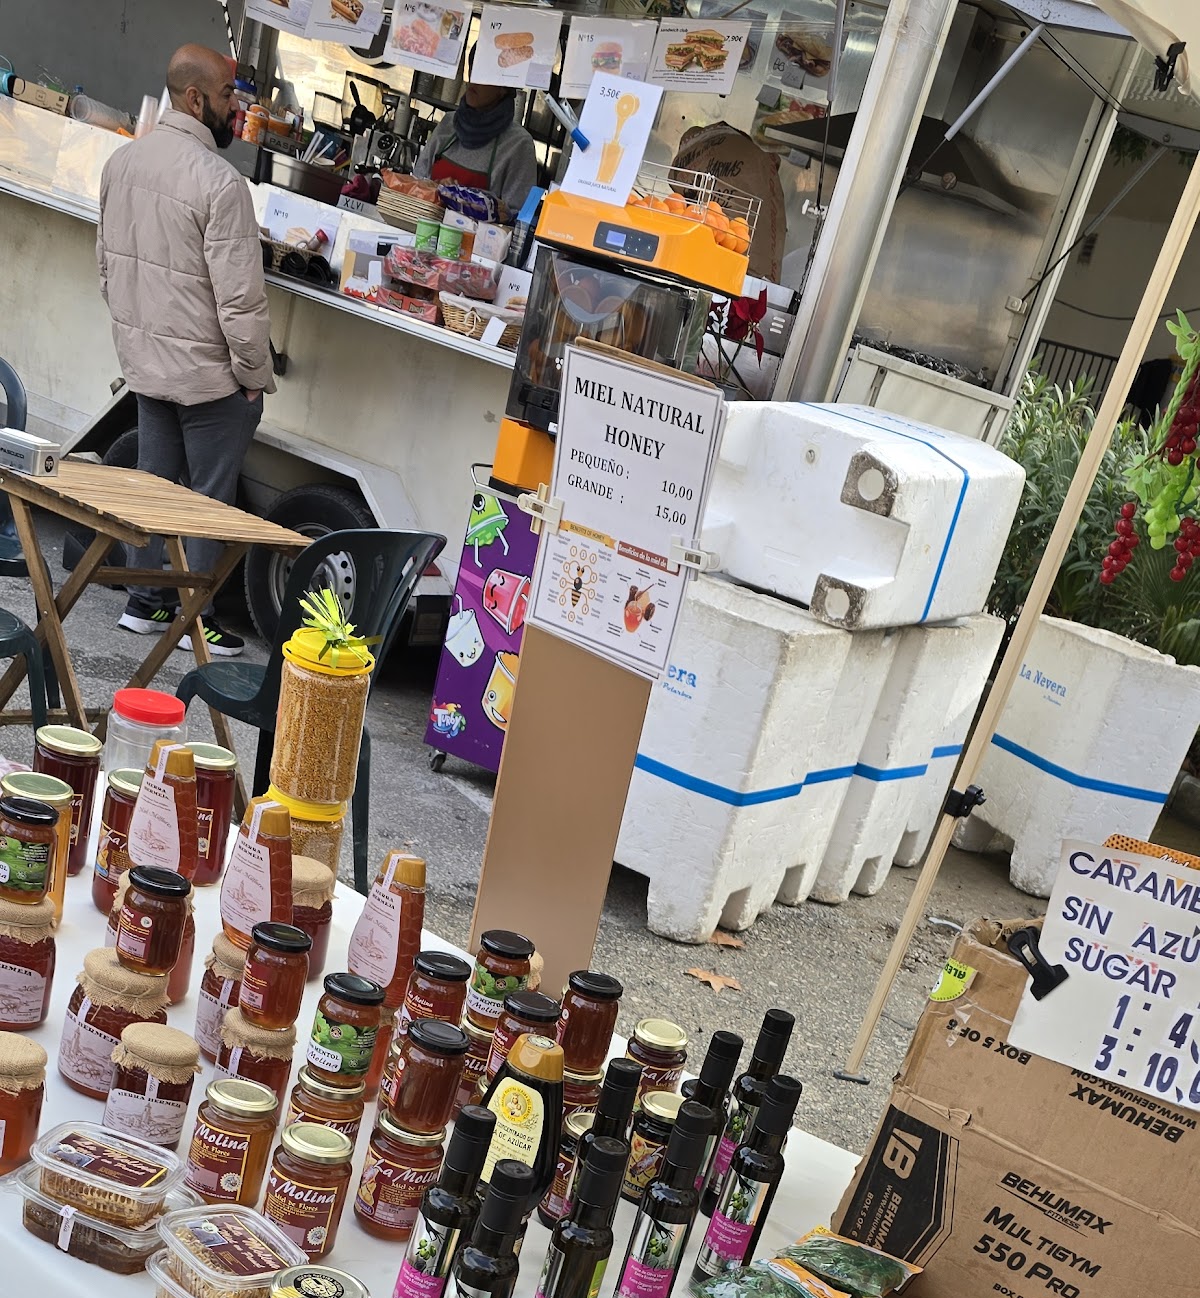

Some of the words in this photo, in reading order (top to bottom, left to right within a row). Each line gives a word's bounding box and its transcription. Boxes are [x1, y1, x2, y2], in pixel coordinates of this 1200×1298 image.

[724, 34, 744, 43] 7,90€
[599, 86, 621, 99] 3,50€
[574, 376, 617, 406] MIEL
[620, 390, 706, 435] NATURAL
[604, 424, 666, 460] HONEY
[567, 473, 614, 500] GRANDE
[661, 480, 694, 501] 10,00
[654, 504, 687, 526] 15,00
[569, 523, 587, 535] BENEFITS
[592, 531, 606, 541] HONEY
[618, 542, 640, 559] Beneficios
[651, 556, 661, 565] miel
[668, 664, 697, 688] era
[1019, 663, 1032, 680] La
[1033, 669, 1067, 698] Nevera
[1062, 895, 1114, 936] SIN
[1064, 937, 1178, 999] SUGAR
[946, 1018, 959, 1031] 6
[958, 1026, 981, 1043] OF
[314, 1045, 340, 1061] MENTOL
[982, 1036, 996, 1049] 5
[994, 1041, 1033, 1066] BOX
[1070, 1067, 1198, 1130] WWW.BEHUMAX.COM
[1068, 1082, 1185, 1144] BEHUMAX
[194, 1123, 249, 1151] Molina
[496, 1121, 527, 1140] CONCENTRADO
[527, 1135, 535, 1143] DE
[498, 1131, 506, 1141] DE
[507, 1136, 532, 1152] AZÚCAR
[373, 1158, 394, 1178] La
[392, 1167, 439, 1184] Molin
[274, 1179, 336, 1204] Molina
[391, 1182, 407, 1191] Miel
[299, 1202, 319, 1212] Flores
[861, 1191, 875, 1212] BOX
[1000, 1171, 1114, 1235] BEHUMAX
[855, 1216, 865, 1231] OF
[866, 1184, 893, 1247] WWW.BEHUMAX.
[1045, 1209, 1081, 1230] FITNESS
[851, 1230, 858, 1238] 6
[972, 1233, 1027, 1271] 550
[992, 1282, 1016, 1298] BOX
